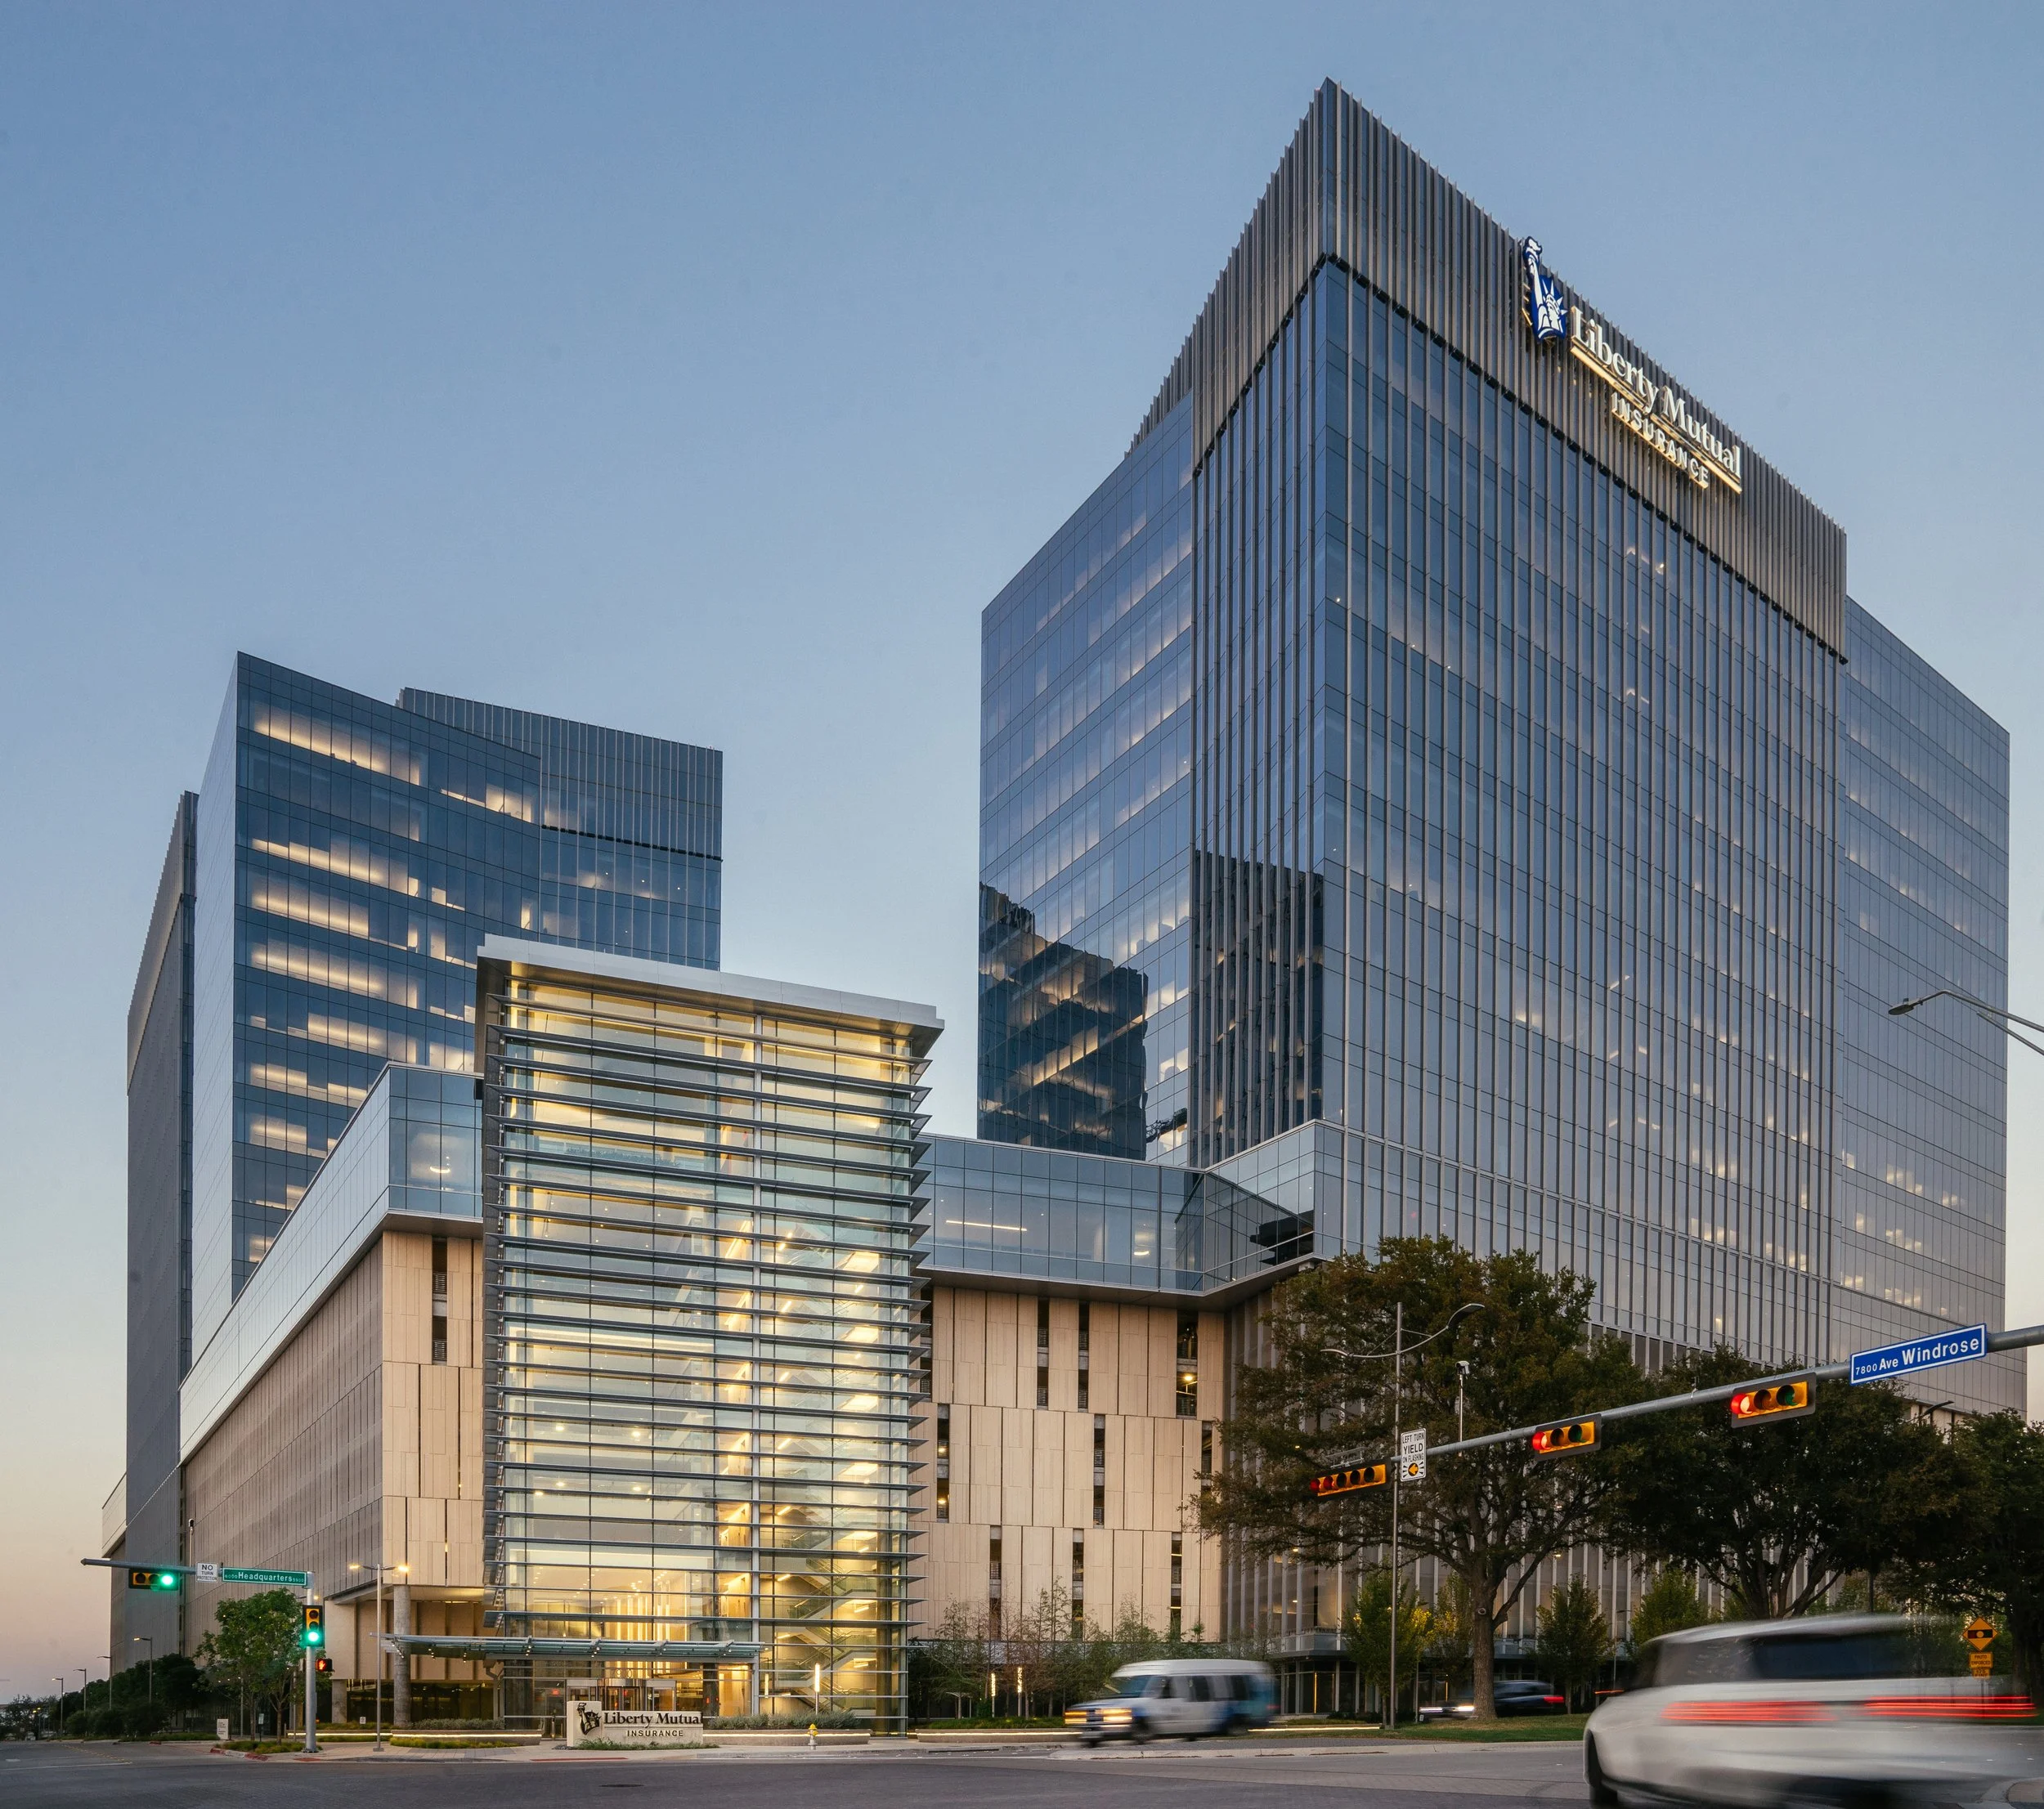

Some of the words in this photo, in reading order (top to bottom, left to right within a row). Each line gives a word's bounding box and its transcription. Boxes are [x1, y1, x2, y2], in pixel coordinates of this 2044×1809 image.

[1571, 305, 1660, 414] Liberty
[1661, 385, 1741, 480] Mutual
[1611, 392, 1709, 484] INSURANCE
[1855, 1363, 1877, 1376] 7800
[1879, 1358, 1898, 1371] Ave
[1902, 1338, 1979, 1366] Windrose
[1402, 1435, 1412, 1444] LEFT
[1414, 1433, 1424, 1441] TURN
[1403, 1444, 1423, 1454] YIELD
[238, 1571, 293, 1583] Headquarters
[603, 1711, 653, 1728] Liberty
[656, 1711, 703, 1724] Mutual
